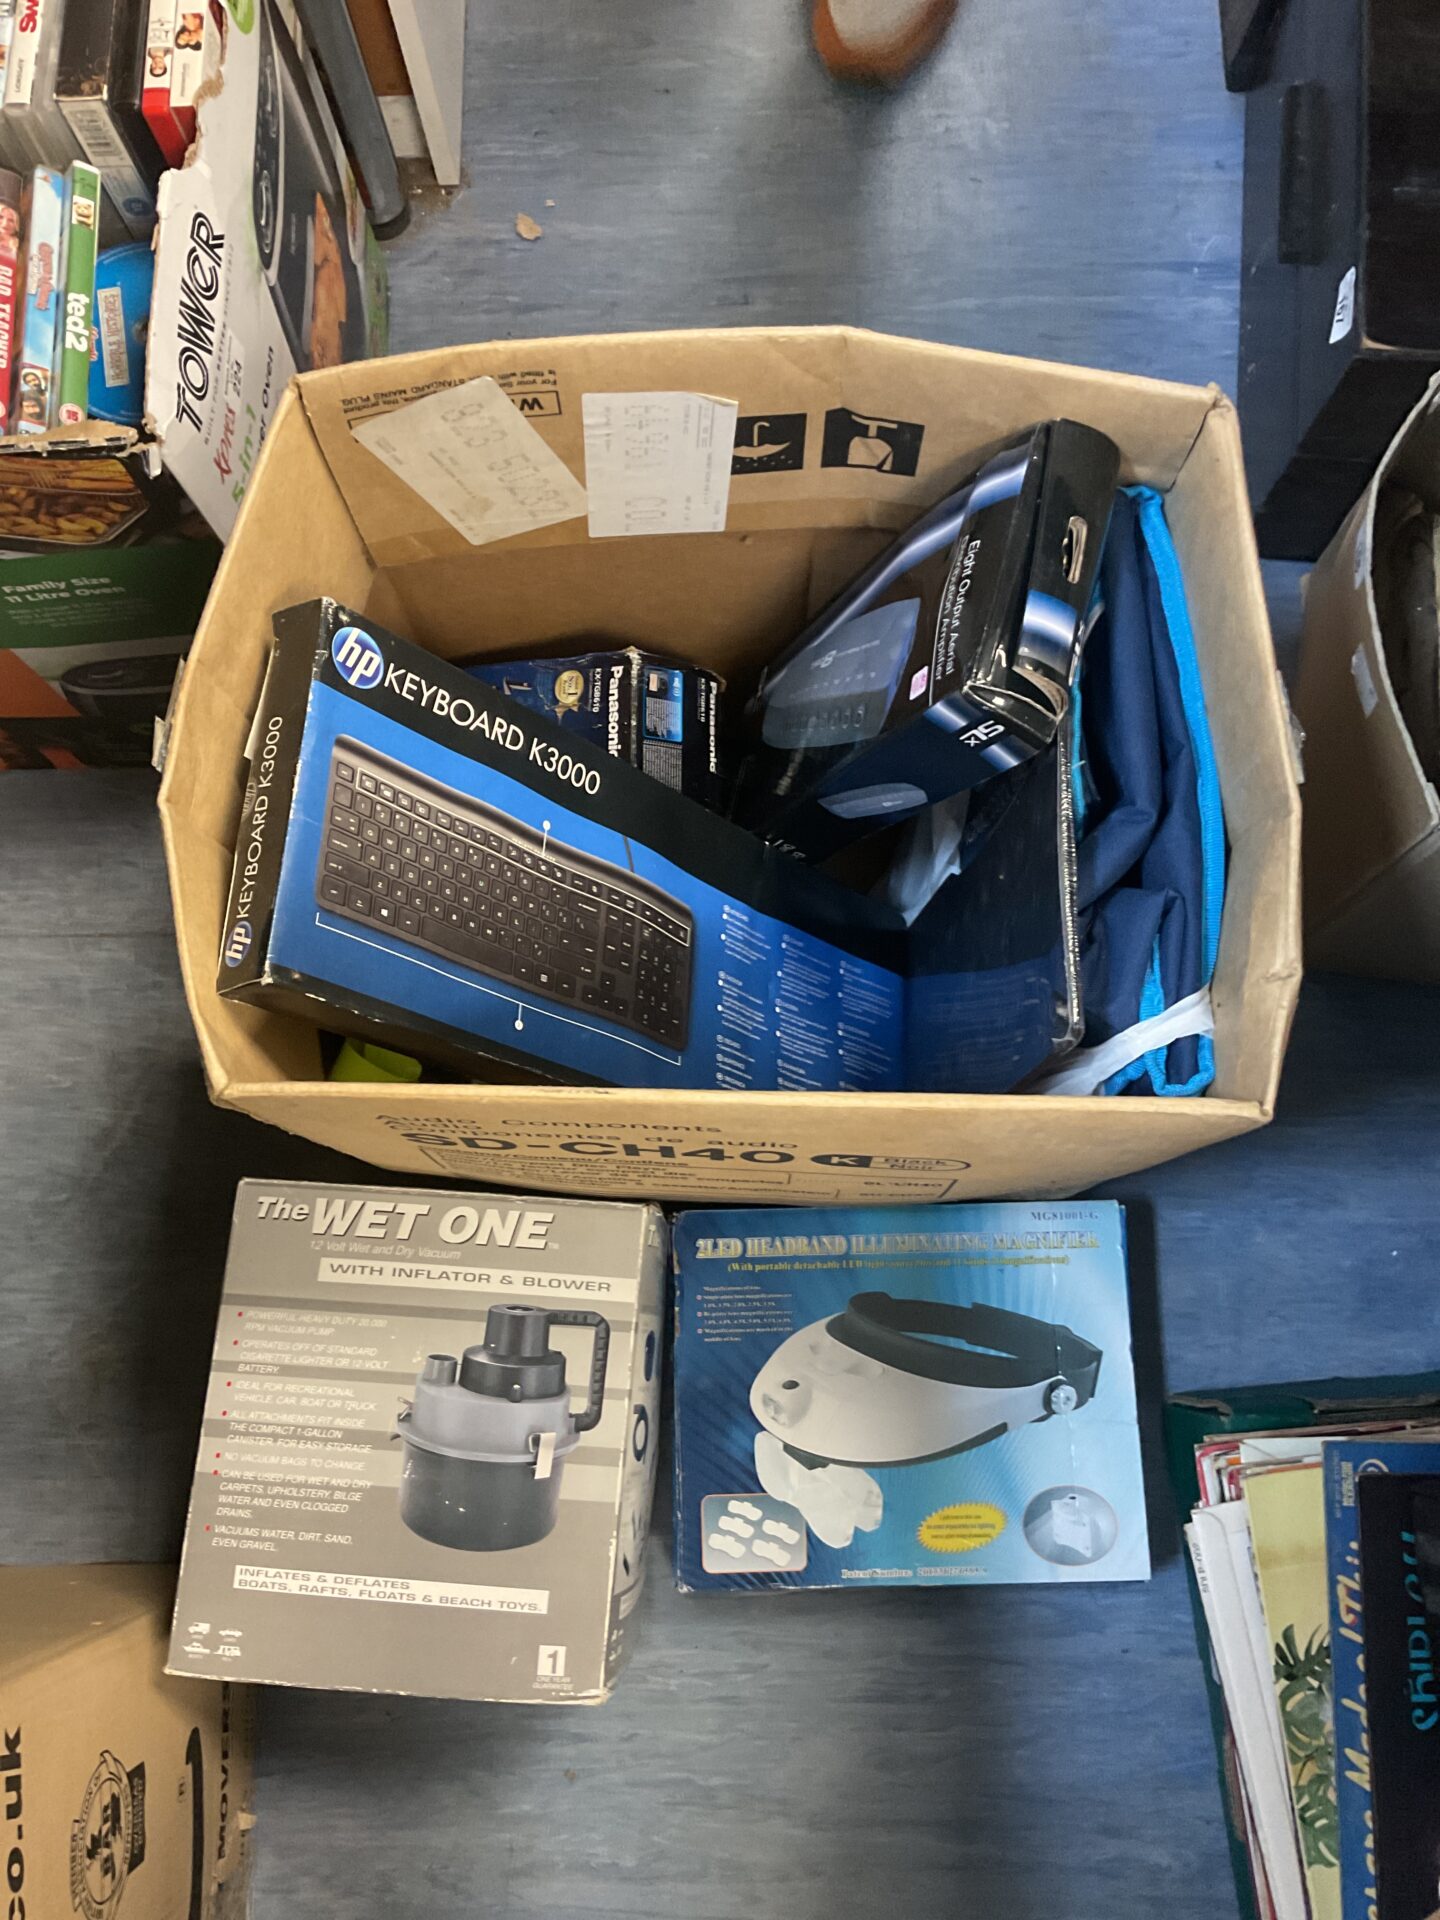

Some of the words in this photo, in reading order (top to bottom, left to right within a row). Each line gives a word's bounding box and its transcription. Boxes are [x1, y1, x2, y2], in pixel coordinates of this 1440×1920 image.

[177, 211, 224, 432] TOWER
[959, 539, 981, 579] Eight
[949, 580, 972, 629] Output
[335, 629, 380, 686] hp
[945, 631, 960, 675] Aerial
[384, 663, 525, 752] KEYBOARD
[529, 737, 601, 795] K3000
[708, 681, 718, 774] Panasonic
[258, 716, 283, 787] K3000
[236, 791, 269, 919] KEYBOARD
[226, 924, 252, 967] hp
[401, 1132, 795, 1163] SD-CH40
[257, 1196, 309, 1222] The
[311, 1199, 430, 1241] WET
[438, 1206, 555, 1250] ONE
[330, 1263, 385, 1277] WITH
[391, 1266, 492, 1285] INFLATOR
[500, 1274, 515, 1286] &
[522, 1276, 612, 1293] BLOWER
[273, 1499, 299, 1509] EVEN
[301, 1502, 349, 1513] CLOGGED
[212, 1537, 237, 1547] EVEN
[238, 1568, 311, 1582] INFLATES
[317, 1575, 328, 1583] &
[333, 1576, 410, 1590] DEFLATES
[358, 1590, 416, 1601] FLOATS
[422, 1594, 433, 1603] &
[439, 1596, 492, 1608] BEACH
